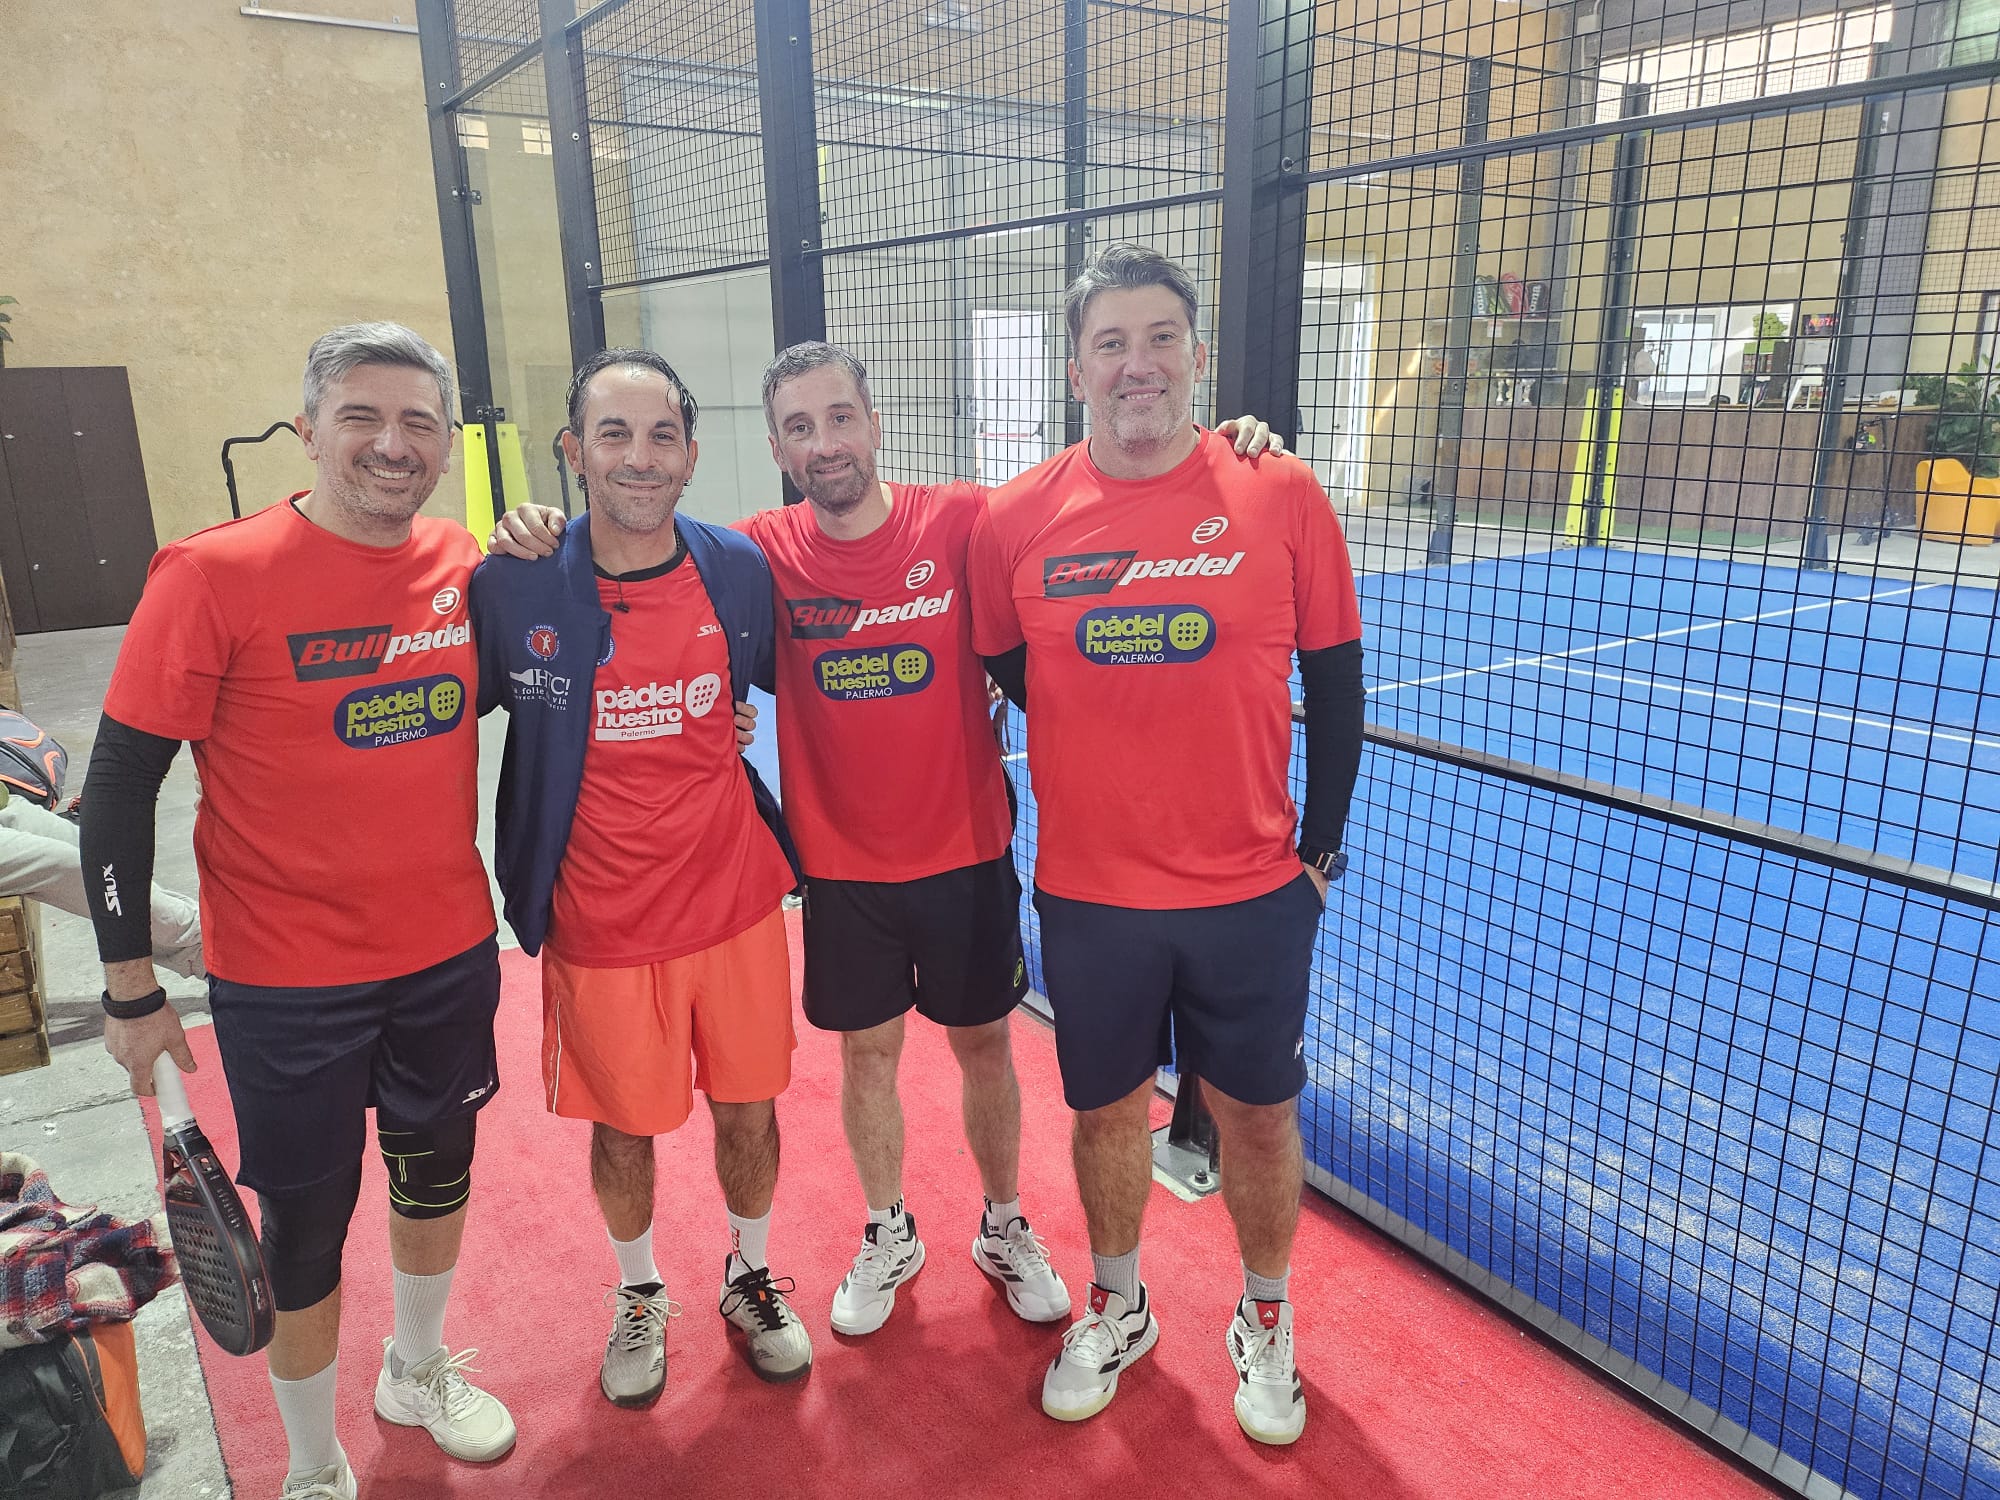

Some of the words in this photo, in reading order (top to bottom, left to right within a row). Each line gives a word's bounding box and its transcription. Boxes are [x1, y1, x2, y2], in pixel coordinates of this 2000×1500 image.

[1047, 552, 1246, 586] Bullpadel
[793, 589, 953, 631] Bullpadel
[696, 623, 723, 638] SIU
[298, 620, 471, 667] Bullpadel
[1085, 637, 1163, 654] nuestro
[1110, 653, 1165, 664] PALERMO
[823, 673, 890, 691] nuestro
[846, 687, 893, 700] PALERMO
[346, 713, 426, 739] nuestro
[598, 707, 683, 728] nuestro
[375, 727, 428, 747] PALERMO
[621, 728, 656, 738] Palermo
